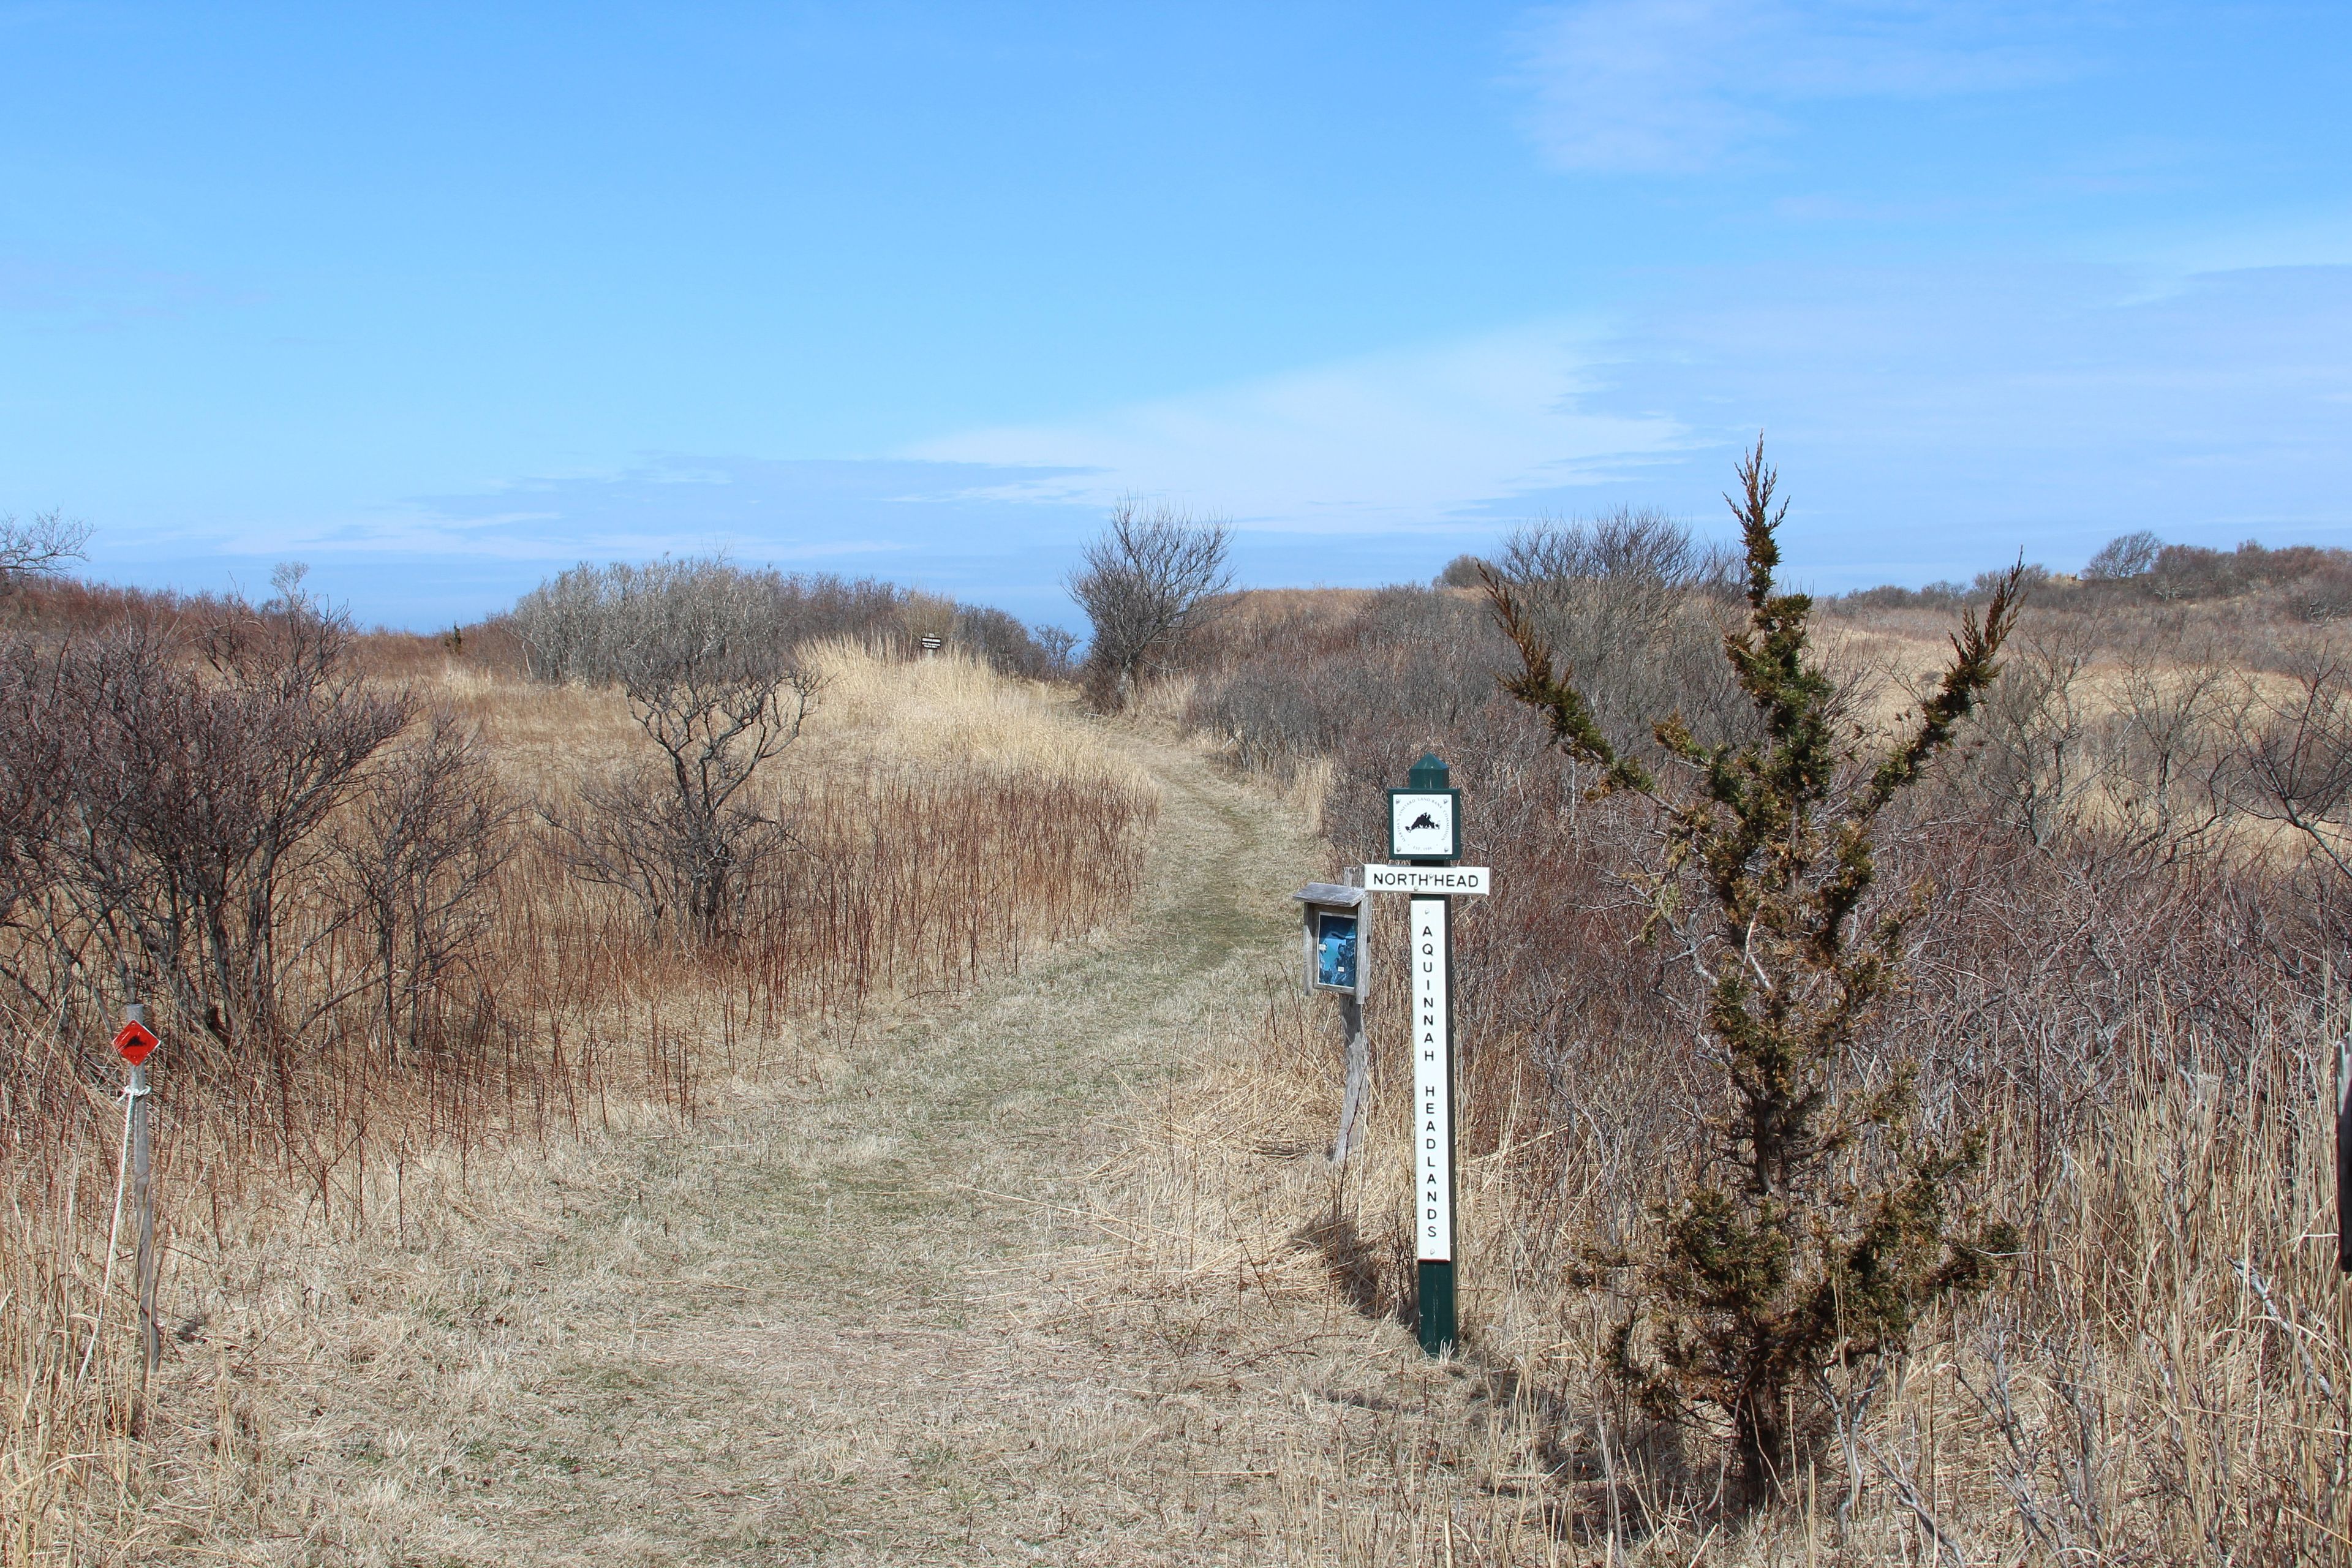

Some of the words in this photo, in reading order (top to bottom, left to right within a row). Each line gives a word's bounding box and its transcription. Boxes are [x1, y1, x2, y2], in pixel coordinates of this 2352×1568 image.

[1398, 799, 1415, 816] VINEYARD
[1431, 799, 1442, 809] BANK
[1373, 873, 1428, 886] NORTH
[1434, 874, 1479, 888] HEAD
[1422, 925, 1434, 1061] AQUINNAH
[1425, 1085, 1437, 1237] HEADLANDS
